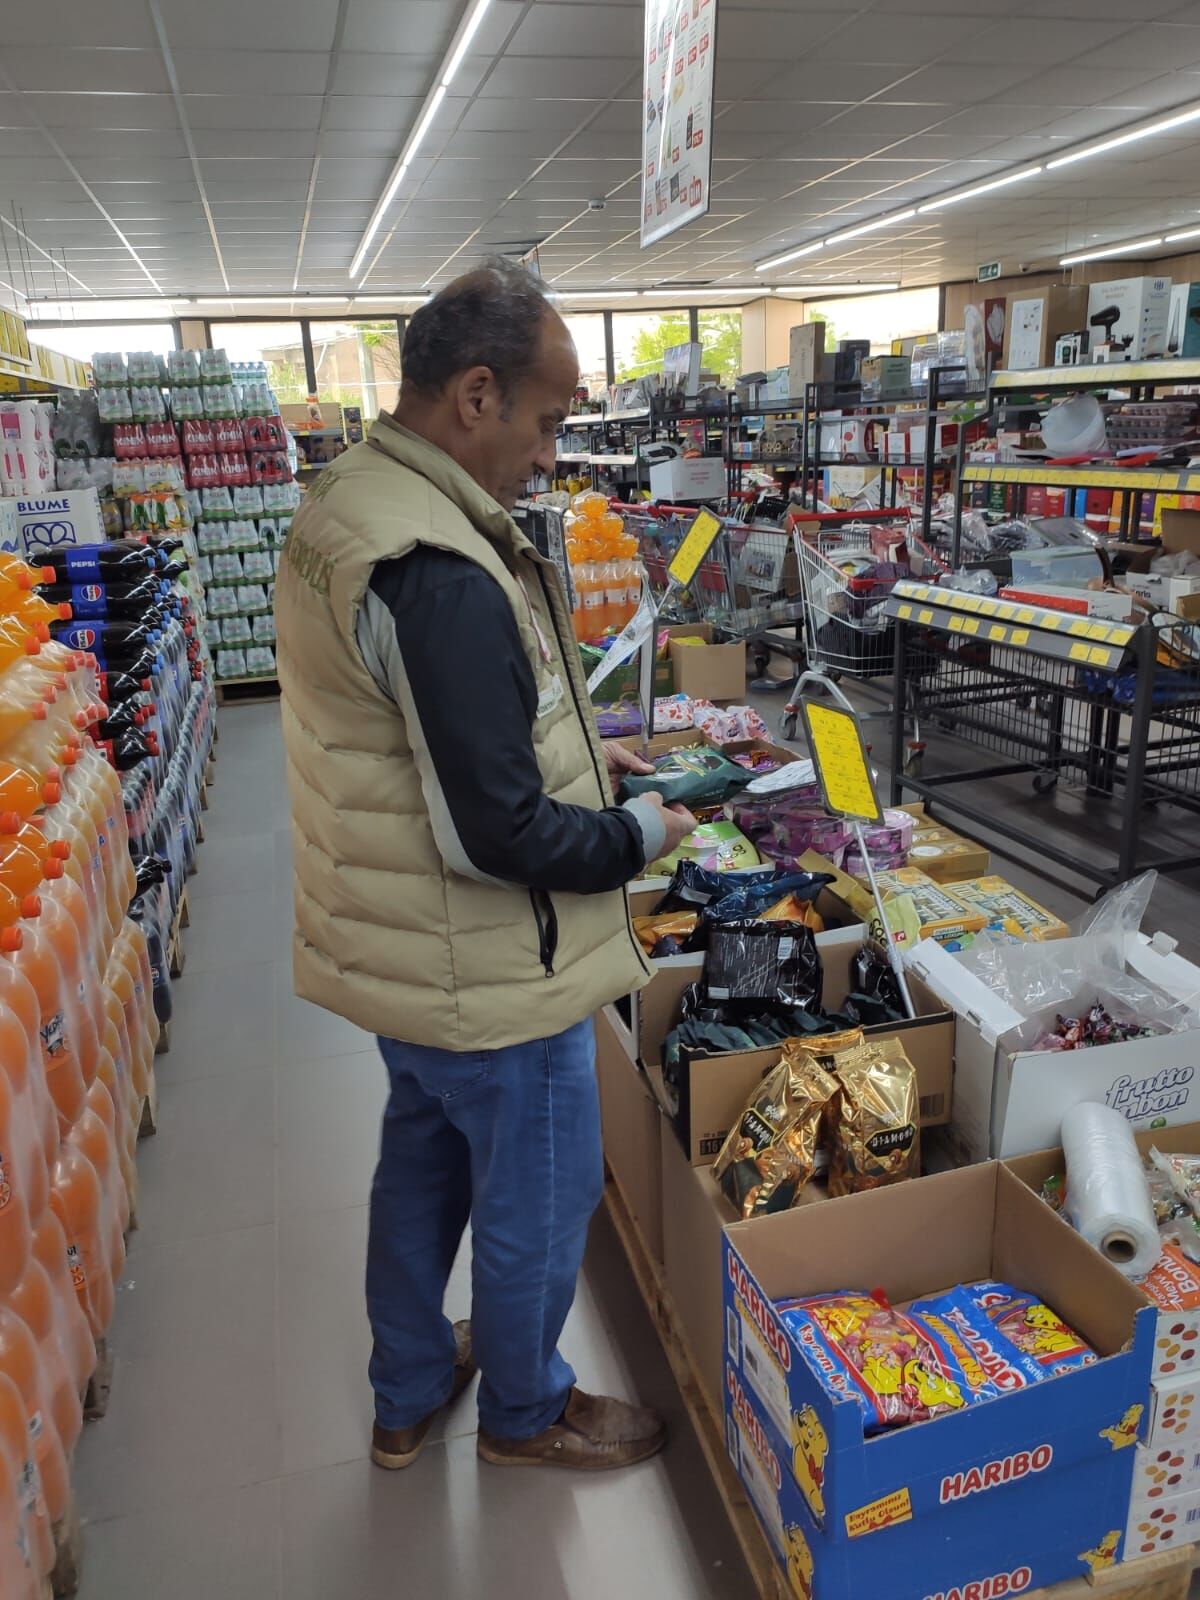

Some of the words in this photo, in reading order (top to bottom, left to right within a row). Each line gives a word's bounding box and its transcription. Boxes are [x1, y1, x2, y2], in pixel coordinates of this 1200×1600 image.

[17, 498, 70, 513] BLUME
[1106, 1066, 1194, 1106] frutto
[727, 1248, 791, 1372] HARIBO
[727, 1362, 782, 1490] HARIBO
[939, 1444, 1053, 1504] HARIBO
